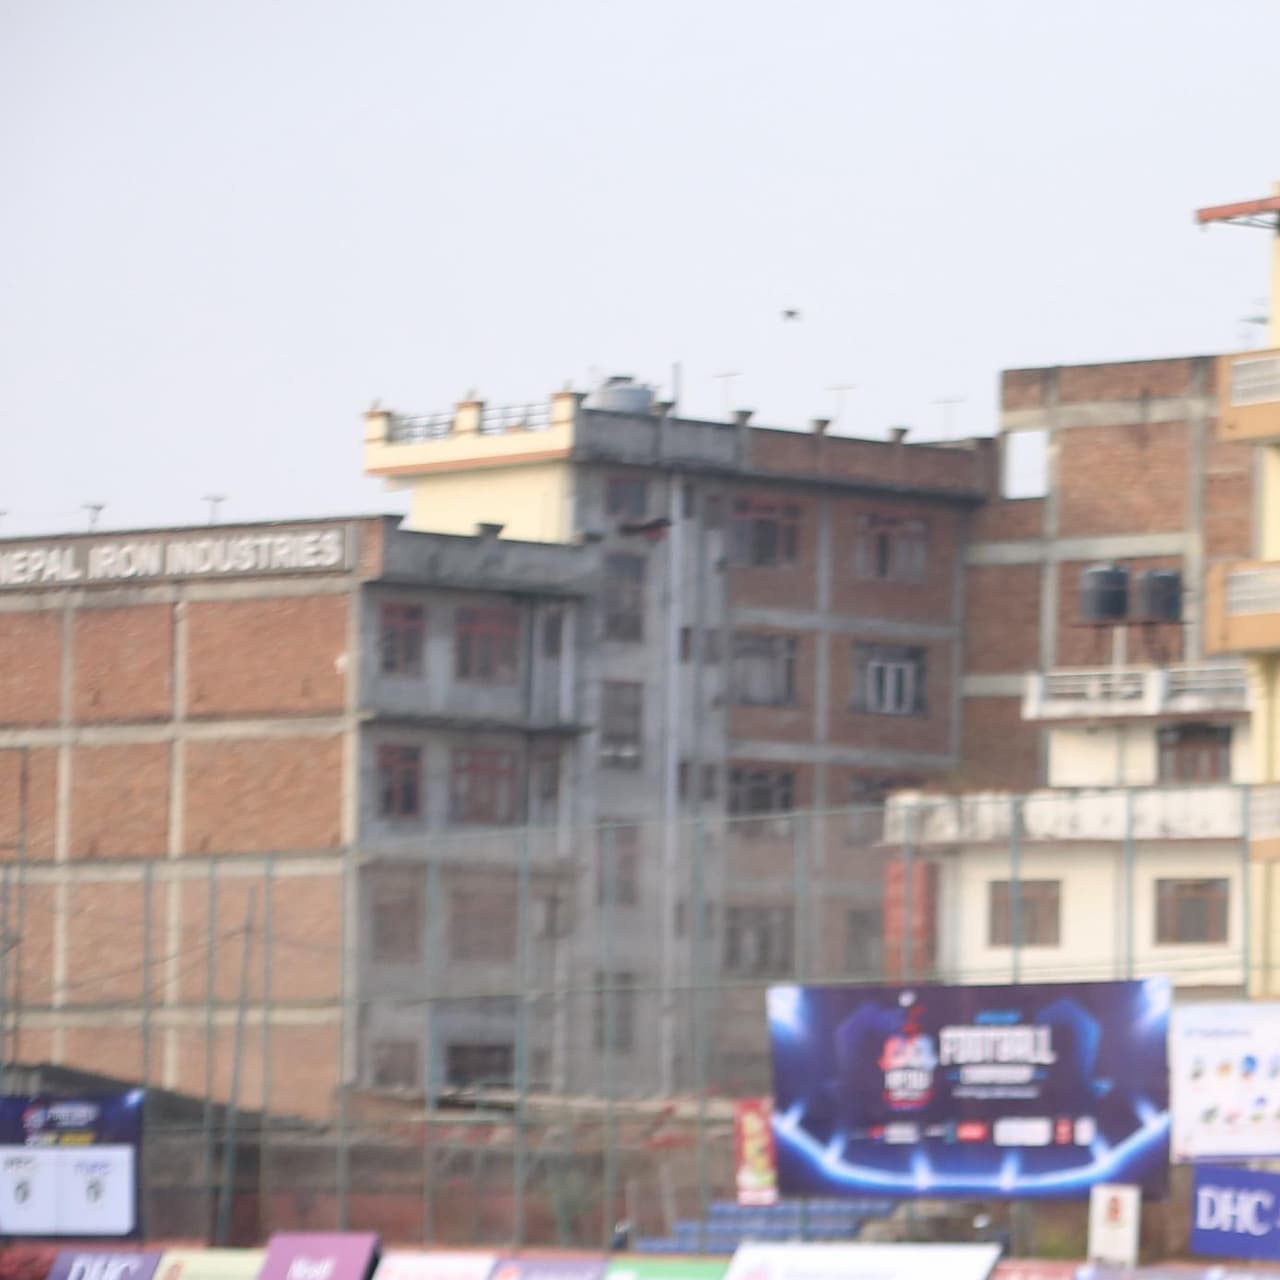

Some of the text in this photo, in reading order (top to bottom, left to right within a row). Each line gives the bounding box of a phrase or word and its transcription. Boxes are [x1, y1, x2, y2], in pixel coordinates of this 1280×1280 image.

[88, 541, 164, 580] IRON
[165, 528, 344, 575] INDUSTRIES
[1197, 1185, 1275, 1236] DHC
